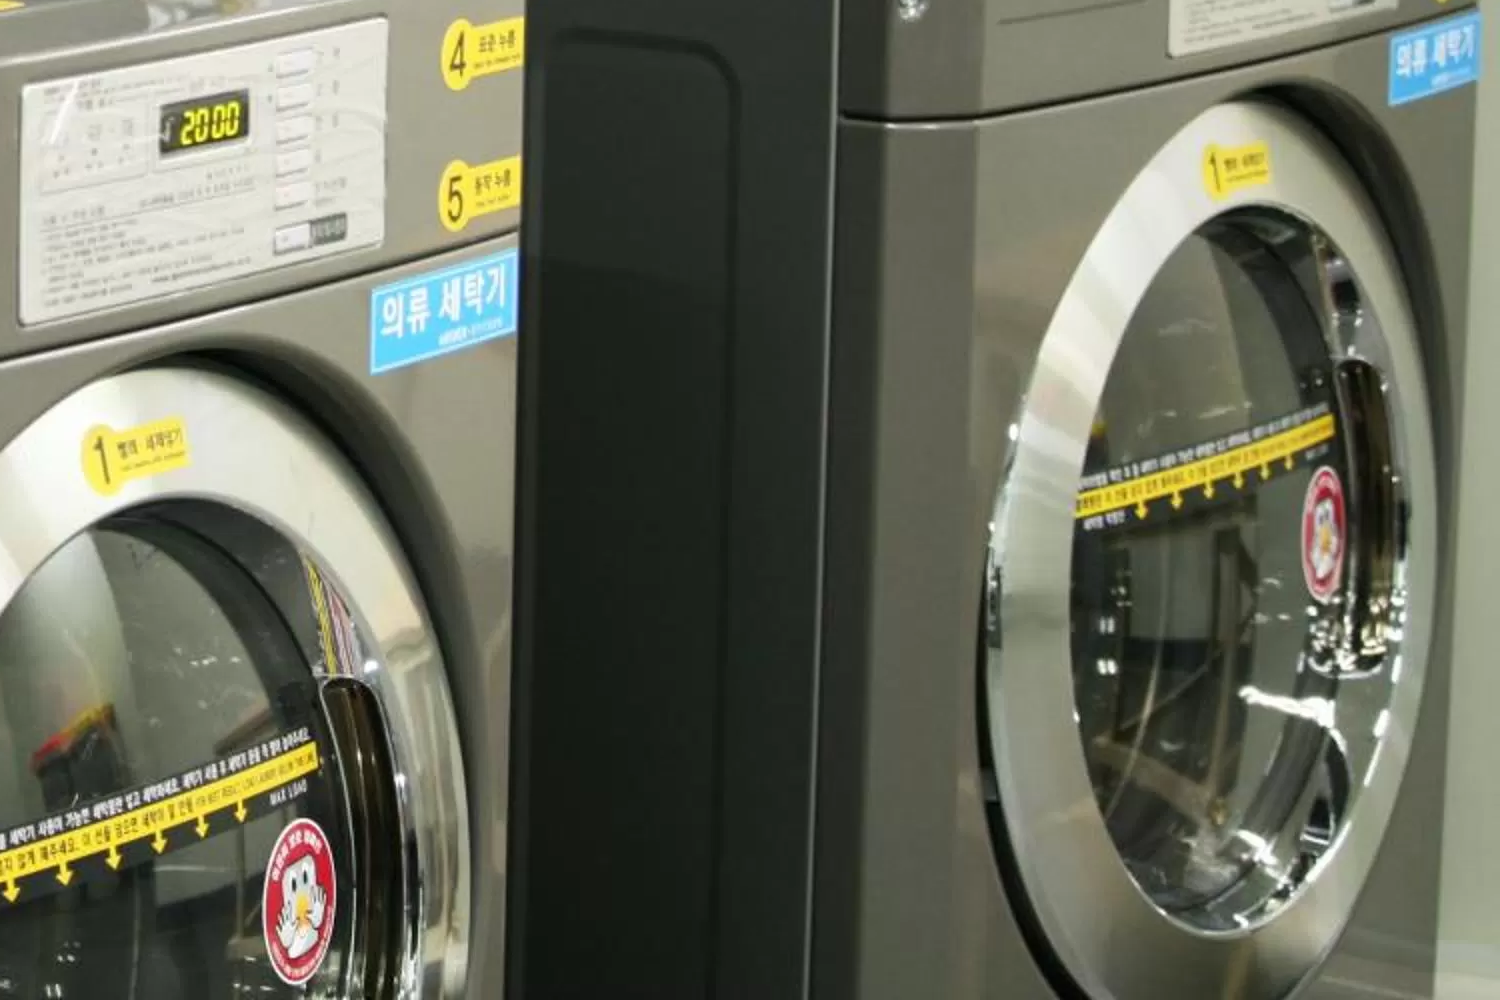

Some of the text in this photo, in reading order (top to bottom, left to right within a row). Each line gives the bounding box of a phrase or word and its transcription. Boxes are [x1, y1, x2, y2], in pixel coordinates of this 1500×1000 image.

[449, 30, 467, 78] 4
[1431, 23, 1475, 68] 세탁기
[179, 100, 241, 147] 2000
[1208, 151, 1221, 193] 1
[447, 174, 464, 223] 5
[380, 263, 506, 338] 의류 세탁기
[92, 435, 111, 485] 1
